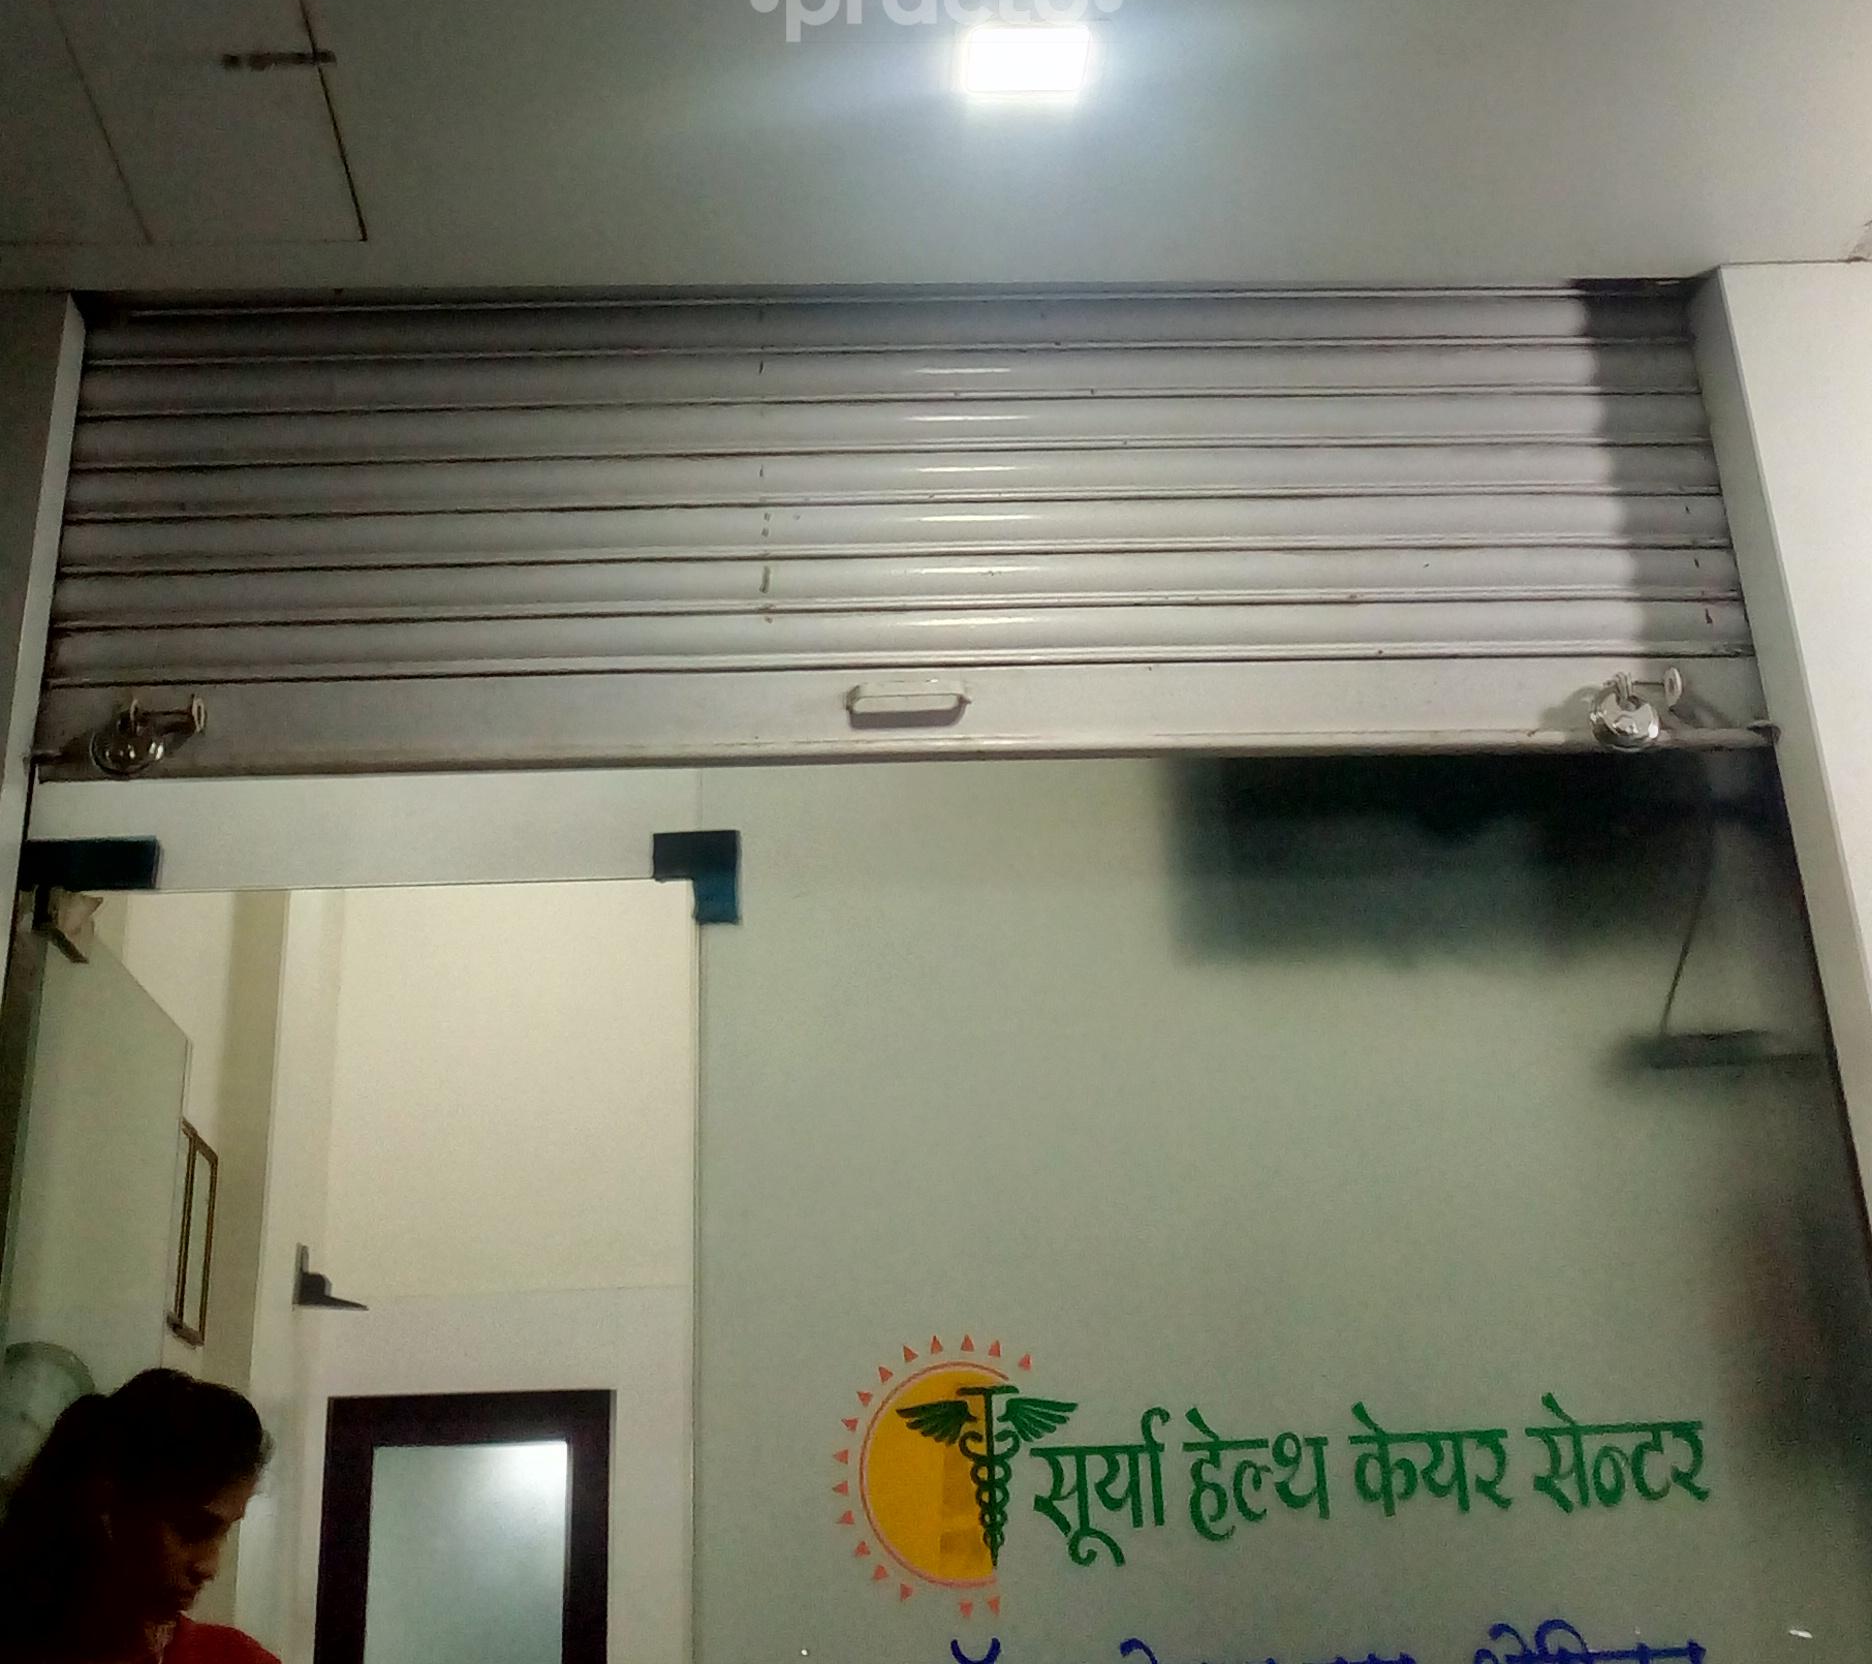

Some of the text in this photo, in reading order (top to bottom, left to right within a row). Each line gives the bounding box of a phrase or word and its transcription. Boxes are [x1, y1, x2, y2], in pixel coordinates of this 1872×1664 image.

[1030, 1392, 1709, 1567] सूर्या हेल्थ केयर सेन्टर
